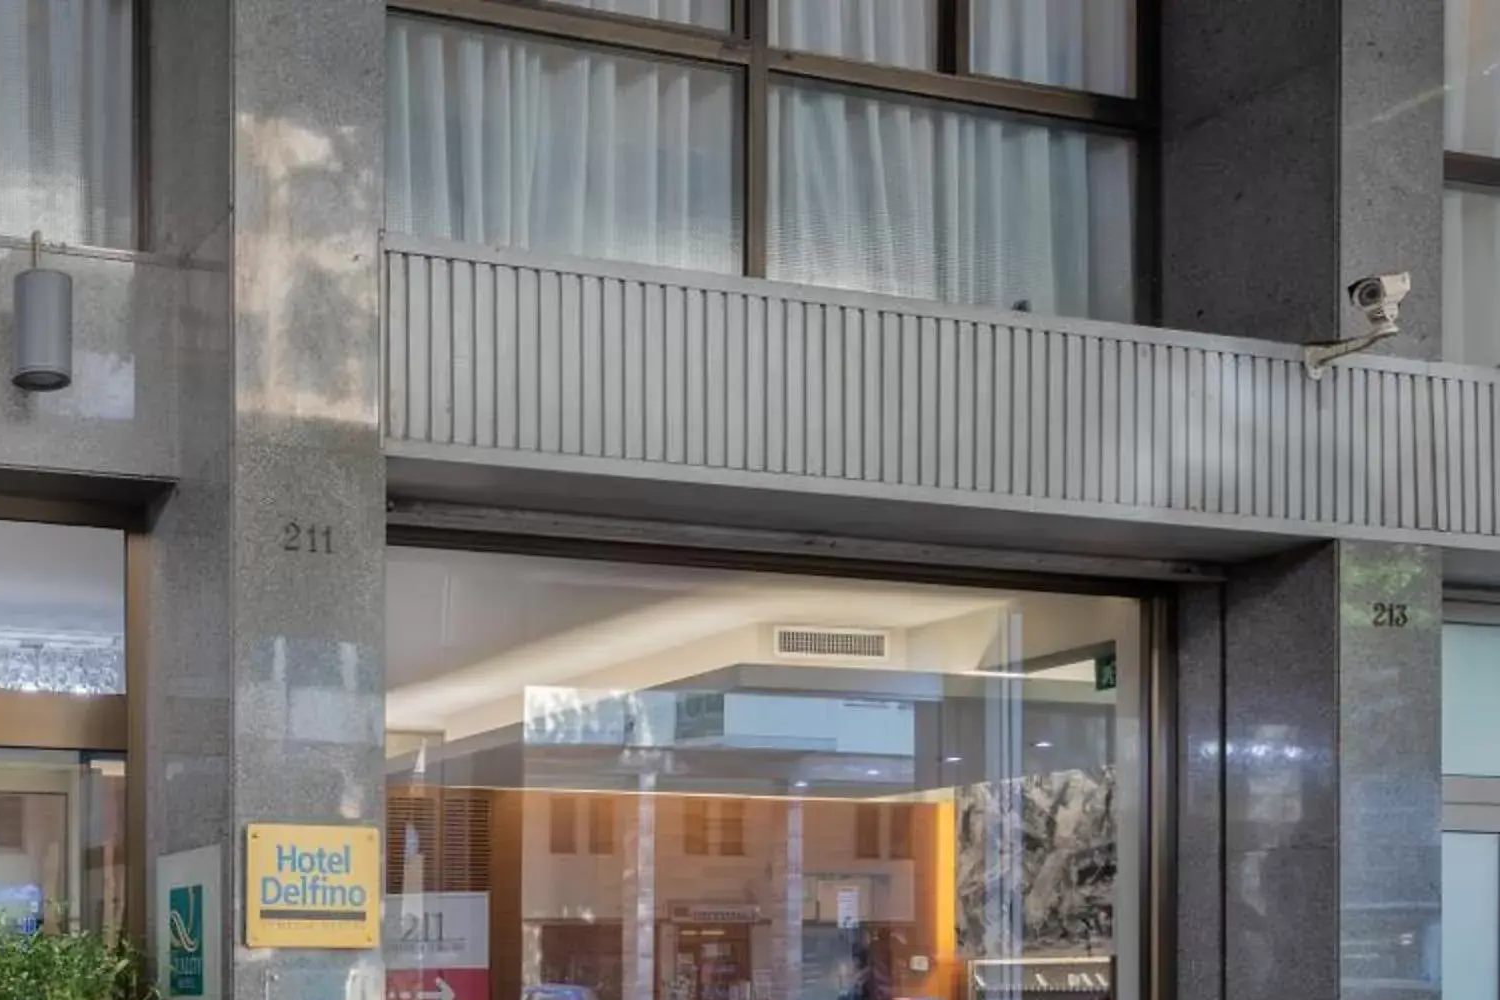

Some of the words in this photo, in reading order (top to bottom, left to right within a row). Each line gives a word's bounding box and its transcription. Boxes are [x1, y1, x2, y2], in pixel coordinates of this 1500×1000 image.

[284, 522, 333, 554] 211
[1373, 602, 1408, 628] 213
[276, 844, 351, 874] Hotel
[261, 875, 367, 907] Delfino
[402, 911, 444, 943] 211
